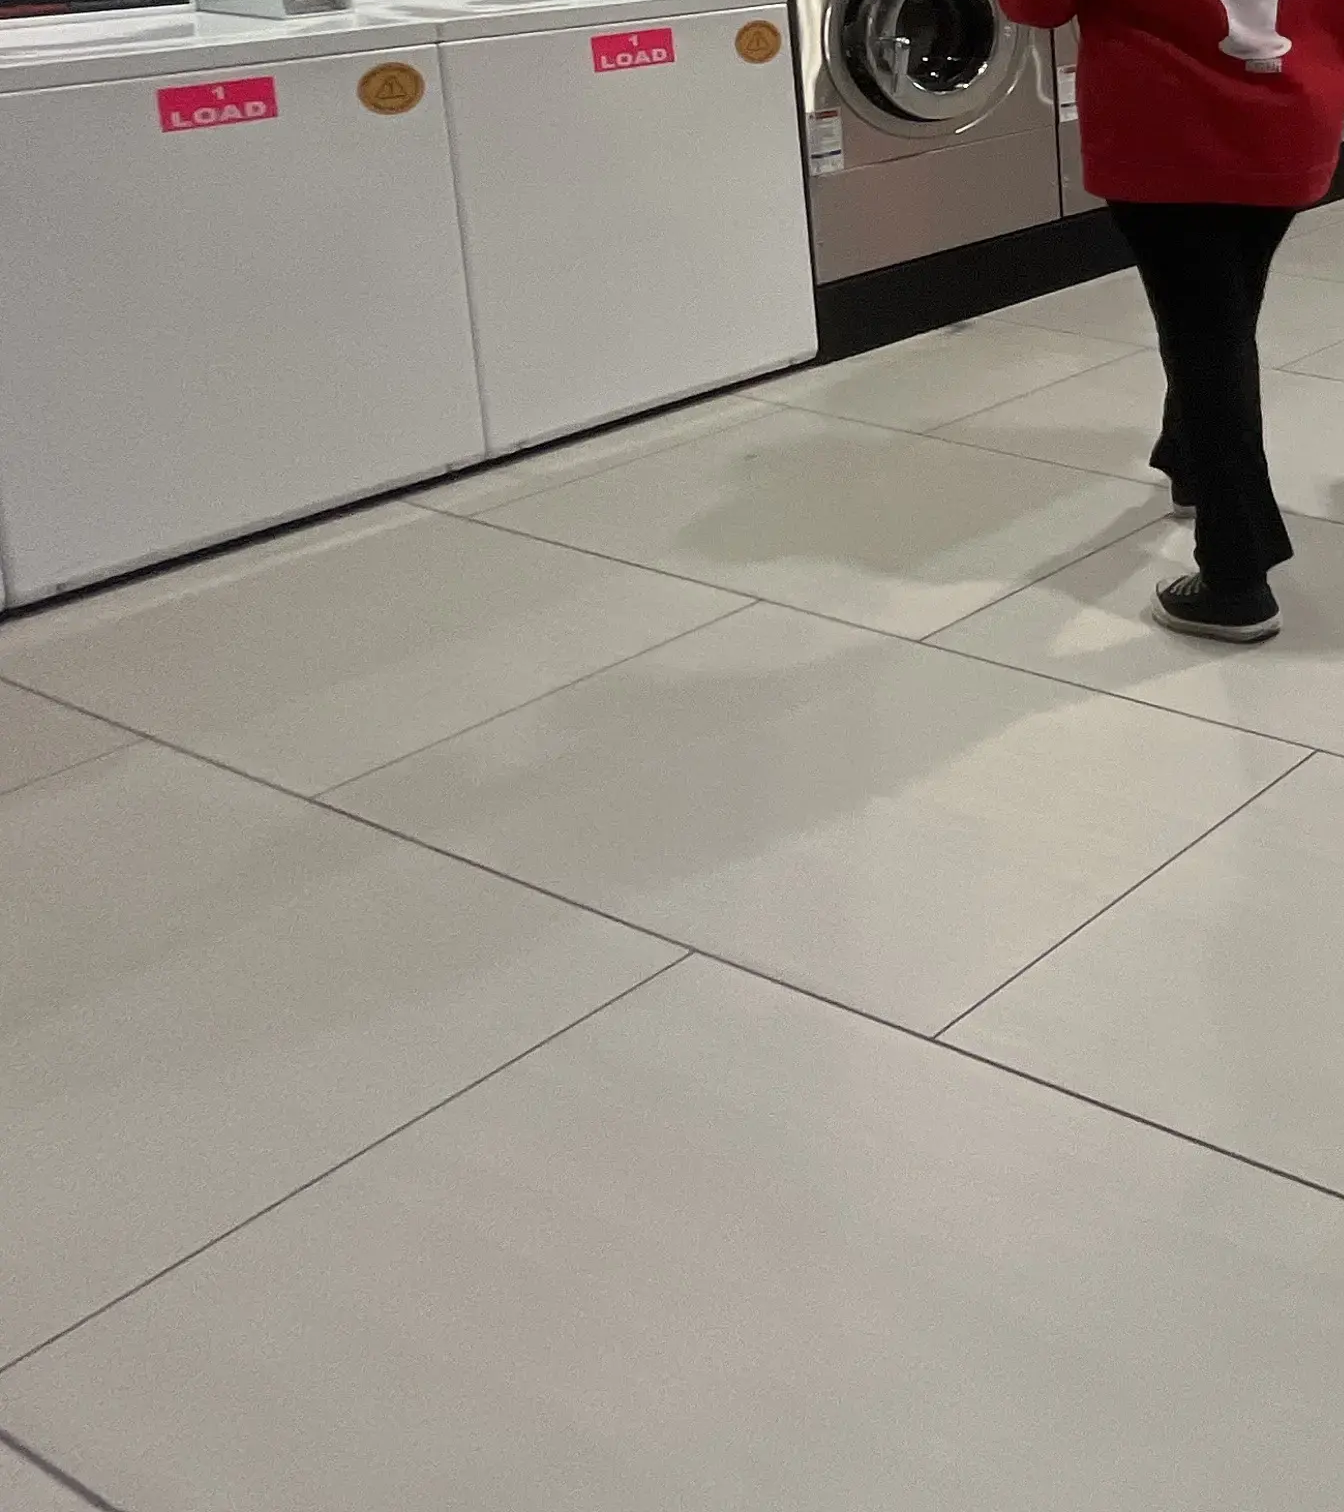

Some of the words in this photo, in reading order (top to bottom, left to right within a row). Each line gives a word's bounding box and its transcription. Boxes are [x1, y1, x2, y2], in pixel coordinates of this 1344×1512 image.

[628, 34, 640, 47] 1
[600, 48, 668, 70] LOAD
[210, 86, 225, 101] 1
[170, 100, 268, 128] LOAD
